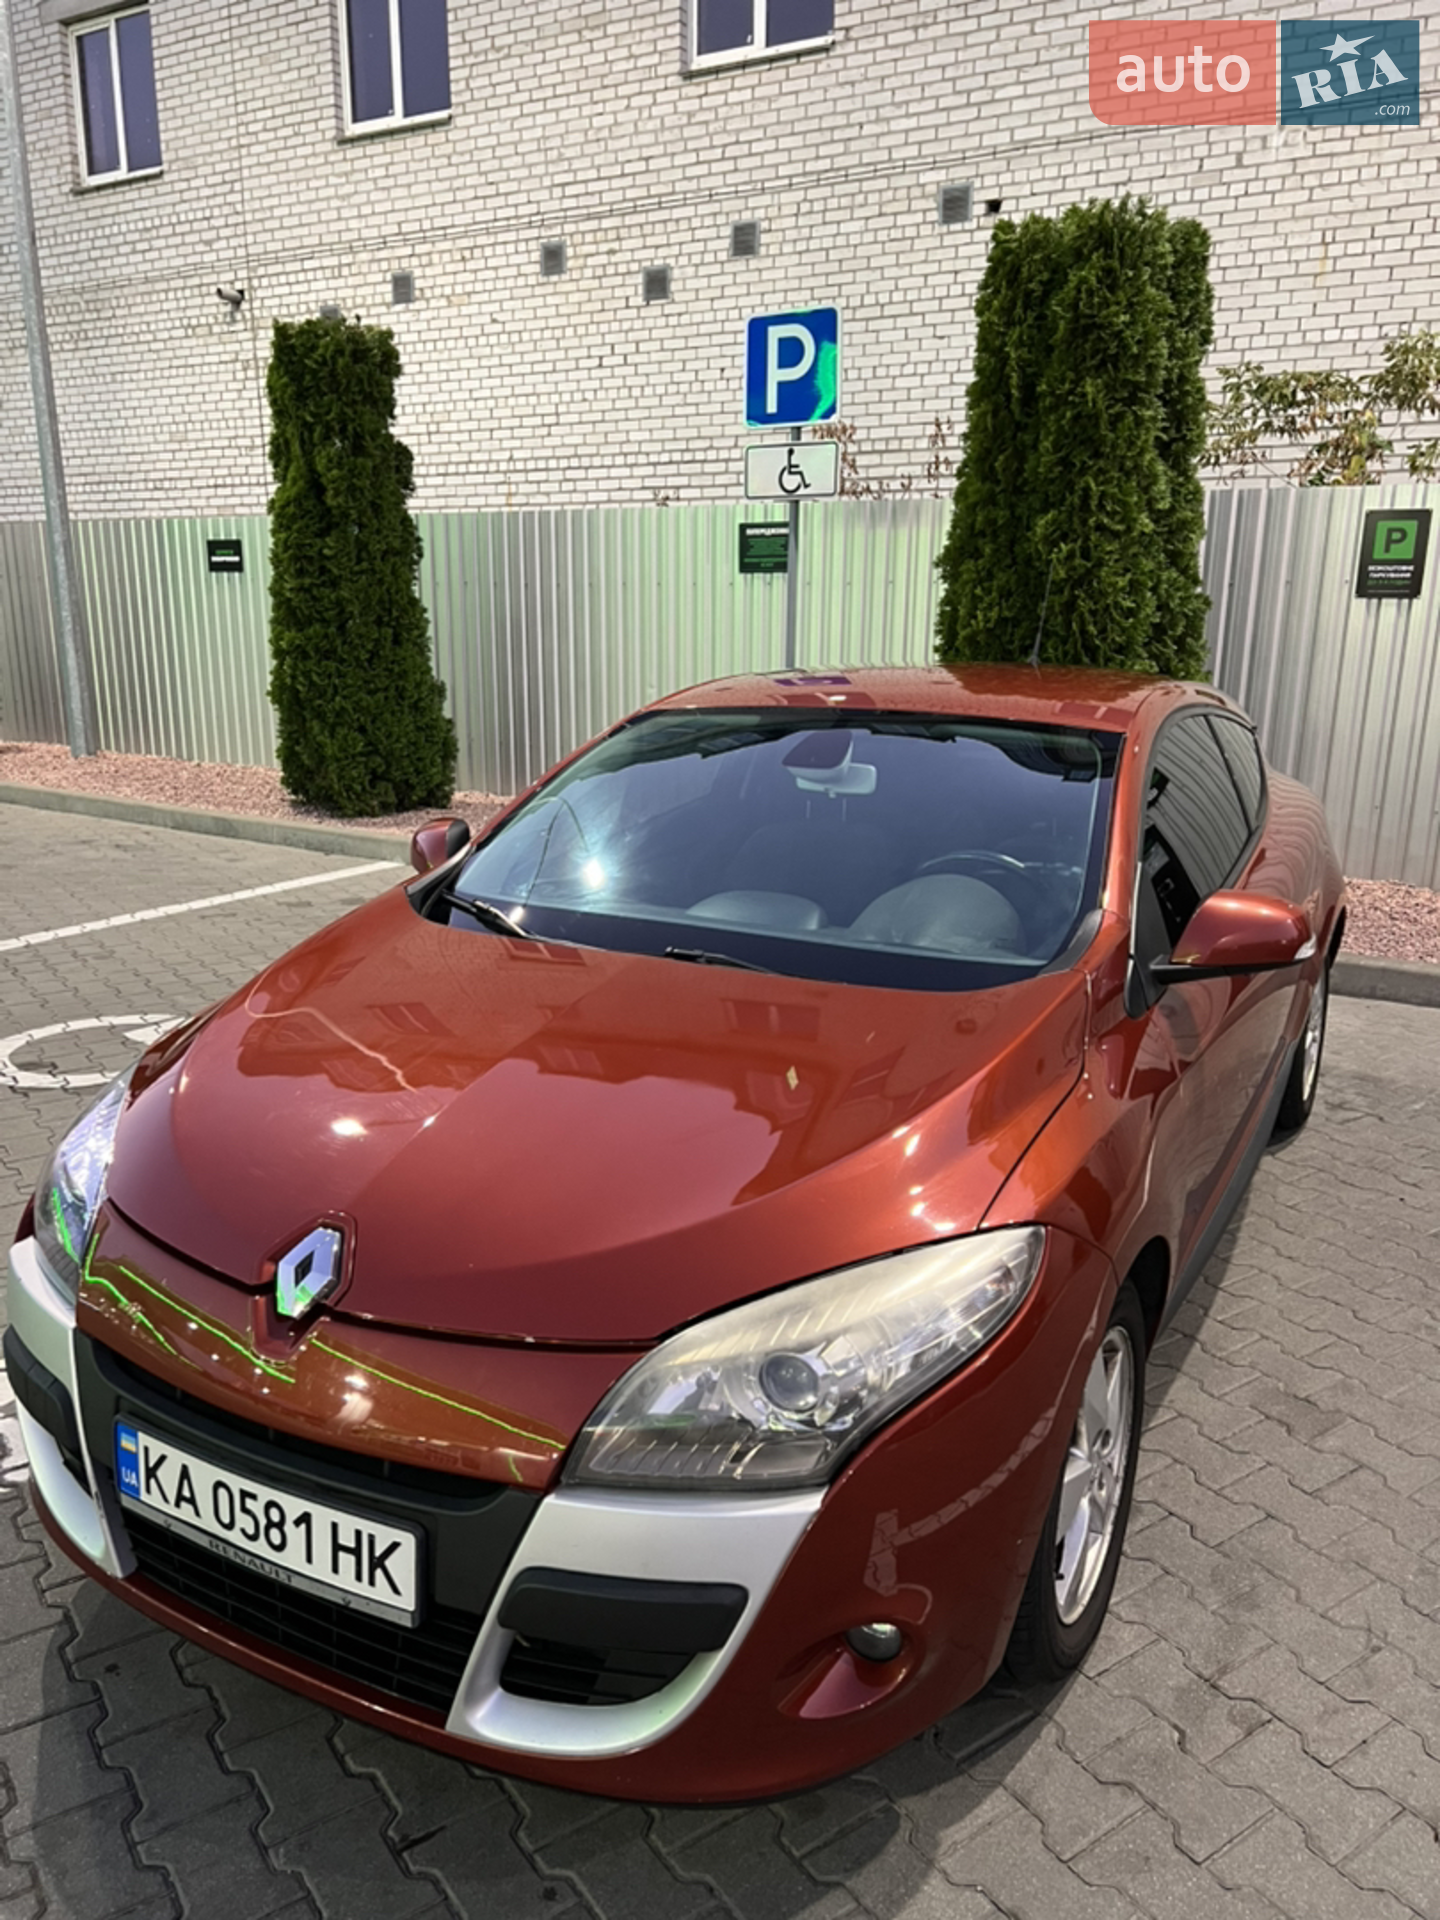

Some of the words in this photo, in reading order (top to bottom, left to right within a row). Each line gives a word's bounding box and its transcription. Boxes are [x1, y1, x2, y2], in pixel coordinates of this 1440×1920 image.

[766, 323, 816, 414] P
[1384, 527, 1408, 554] P
[121, 1466, 138, 1488] UA
[143, 1444, 202, 1519] KA
[212, 1480, 313, 1566] 0581
[330, 1520, 403, 1597] HK
[208, 1539, 294, 1585] RENAULT
